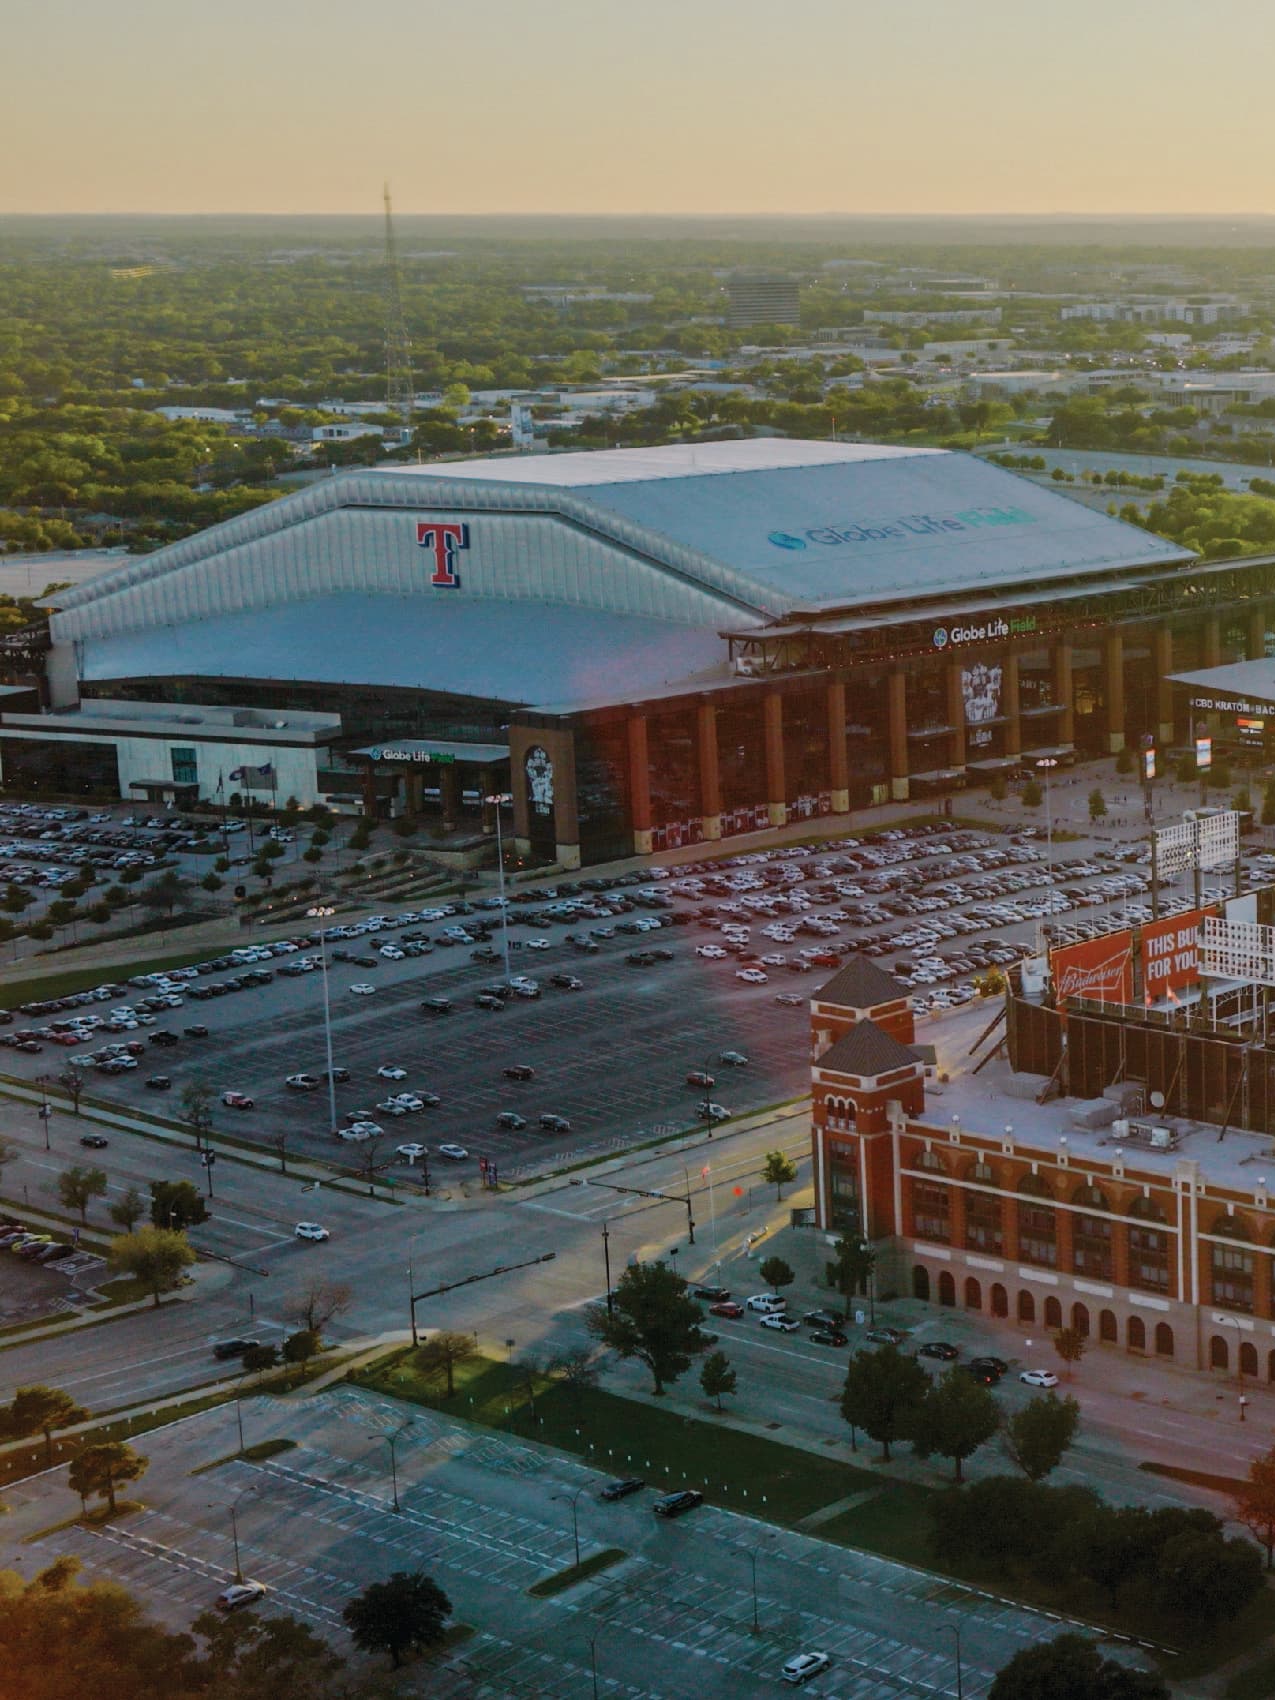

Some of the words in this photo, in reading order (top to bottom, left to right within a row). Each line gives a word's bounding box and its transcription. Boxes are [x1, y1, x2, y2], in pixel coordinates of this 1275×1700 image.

[805, 524, 906, 545] Globe
[897, 514, 966, 535] Life
[416, 522, 469, 588] T
[950, 624, 986, 643] Globe
[987, 617, 1009, 638] Life
[1010, 616, 1036, 634] Field
[1195, 698, 1213, 709] CBD
[1215, 700, 1250, 713] KRATOM
[383, 749, 411, 761] Globe
[413, 751, 431, 763] Life
[1147, 932, 1175, 958] THIS
[1060, 966, 1122, 992] Budweiser
[1147, 956, 1171, 981] FOR
